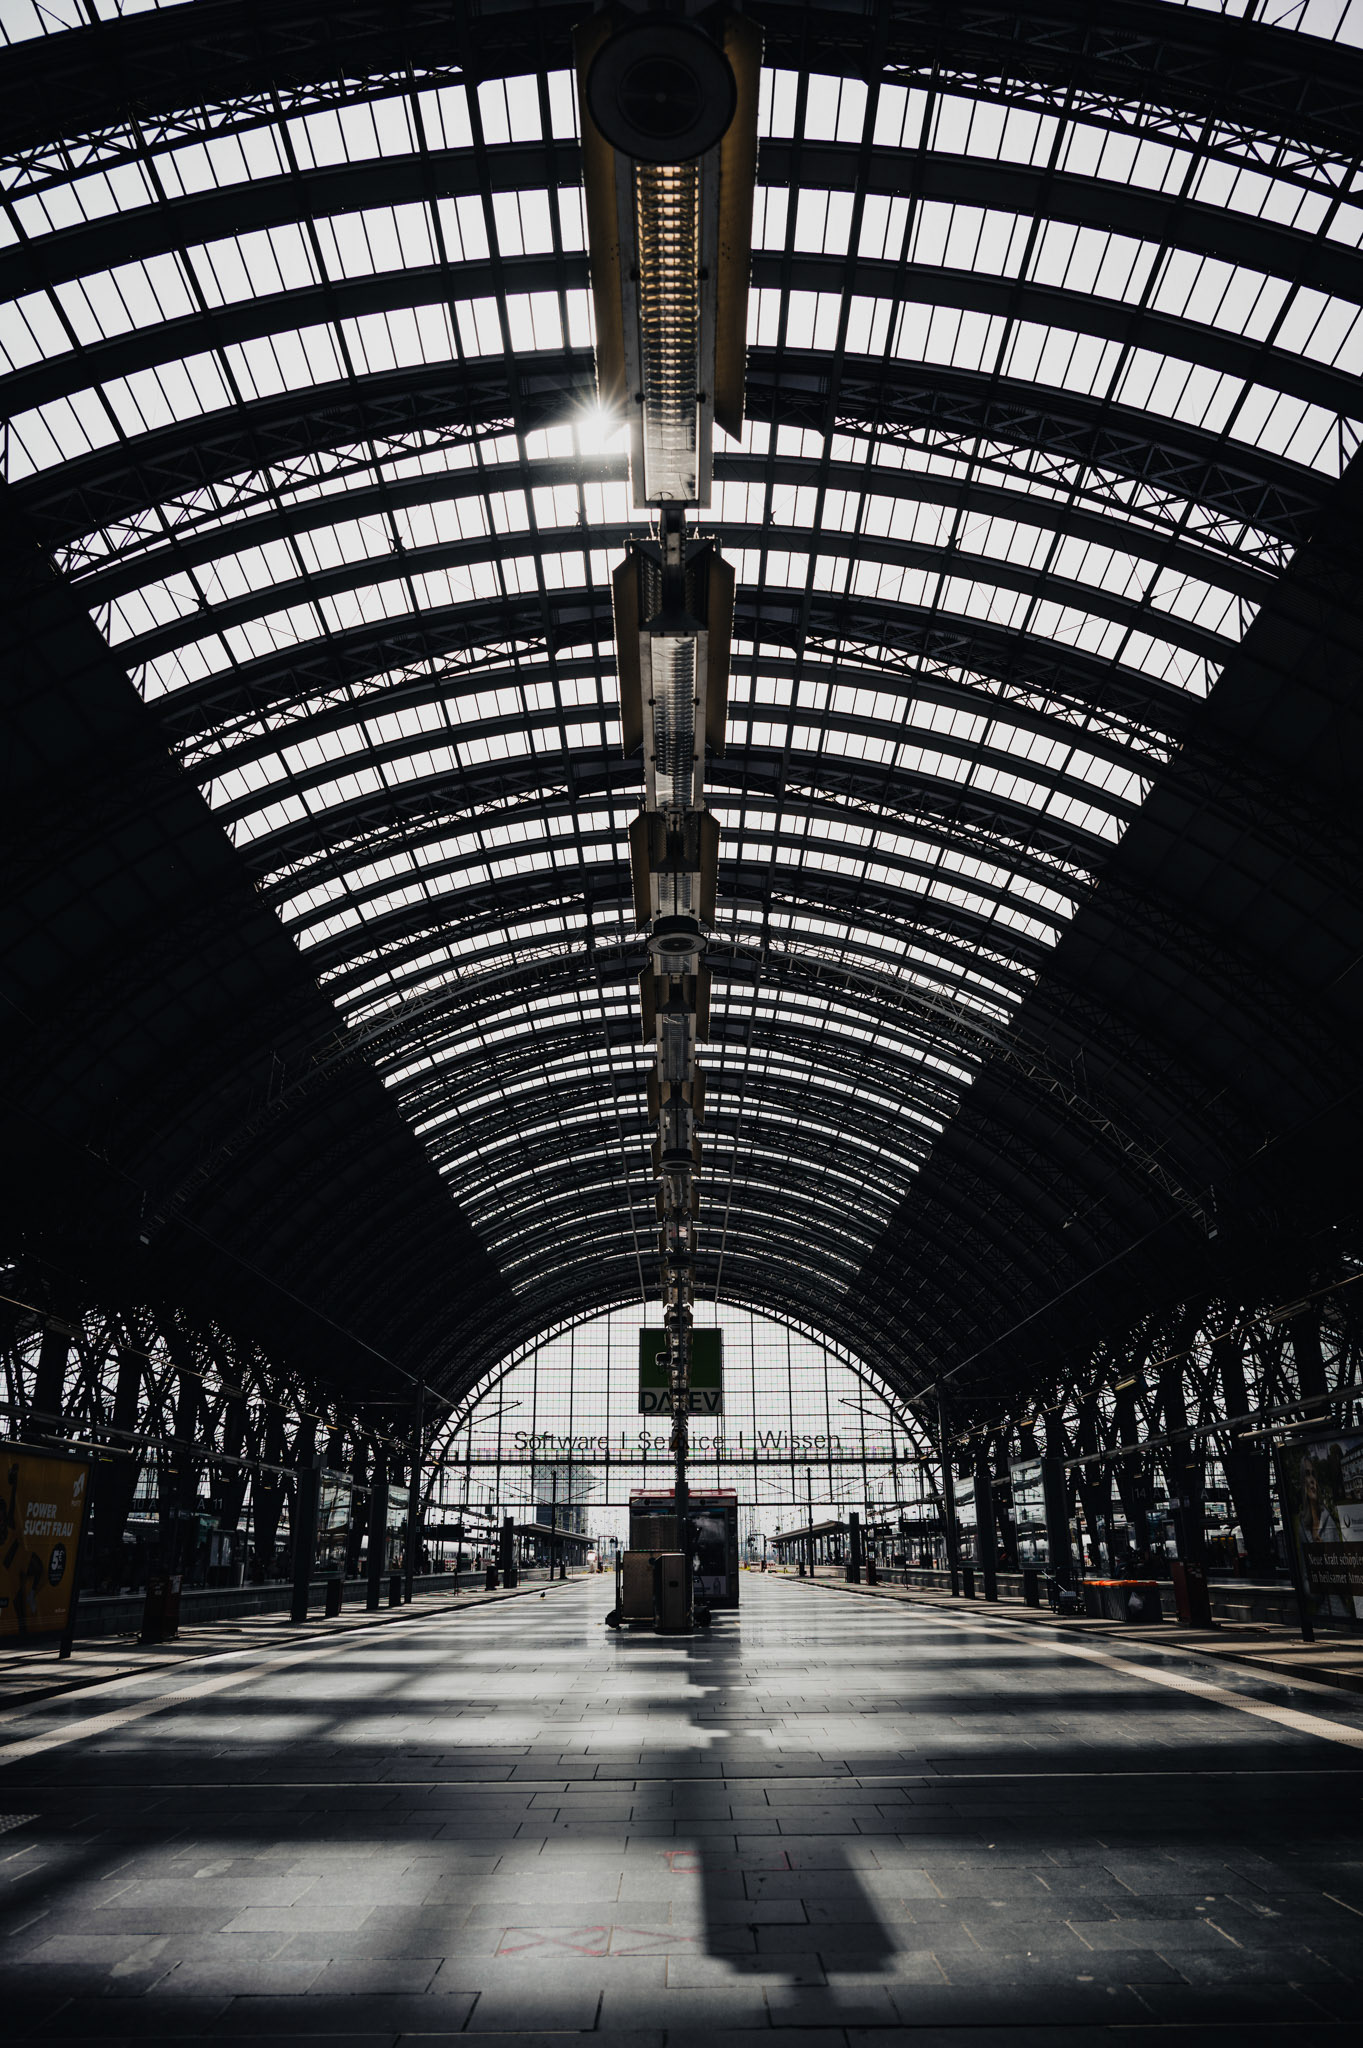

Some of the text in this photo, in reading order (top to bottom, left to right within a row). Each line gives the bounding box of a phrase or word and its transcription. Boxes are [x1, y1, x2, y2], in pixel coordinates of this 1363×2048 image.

[641, 1391, 721, 1412] DAEV
[514, 1430, 609, 1450] Software
[638, 1431, 724, 1450] Seice
[758, 1430, 841, 1449] Wissen
[27, 1502, 57, 1520] POWER
[24, 1520, 73, 1537] SUCHT FRAU
[1308, 1552, 1323, 1566] Neue
[1323, 1552, 1339, 1566] Kraft
[1312, 1572, 1318, 1583] in
[1319, 1570, 1347, 1584] heilsamer
